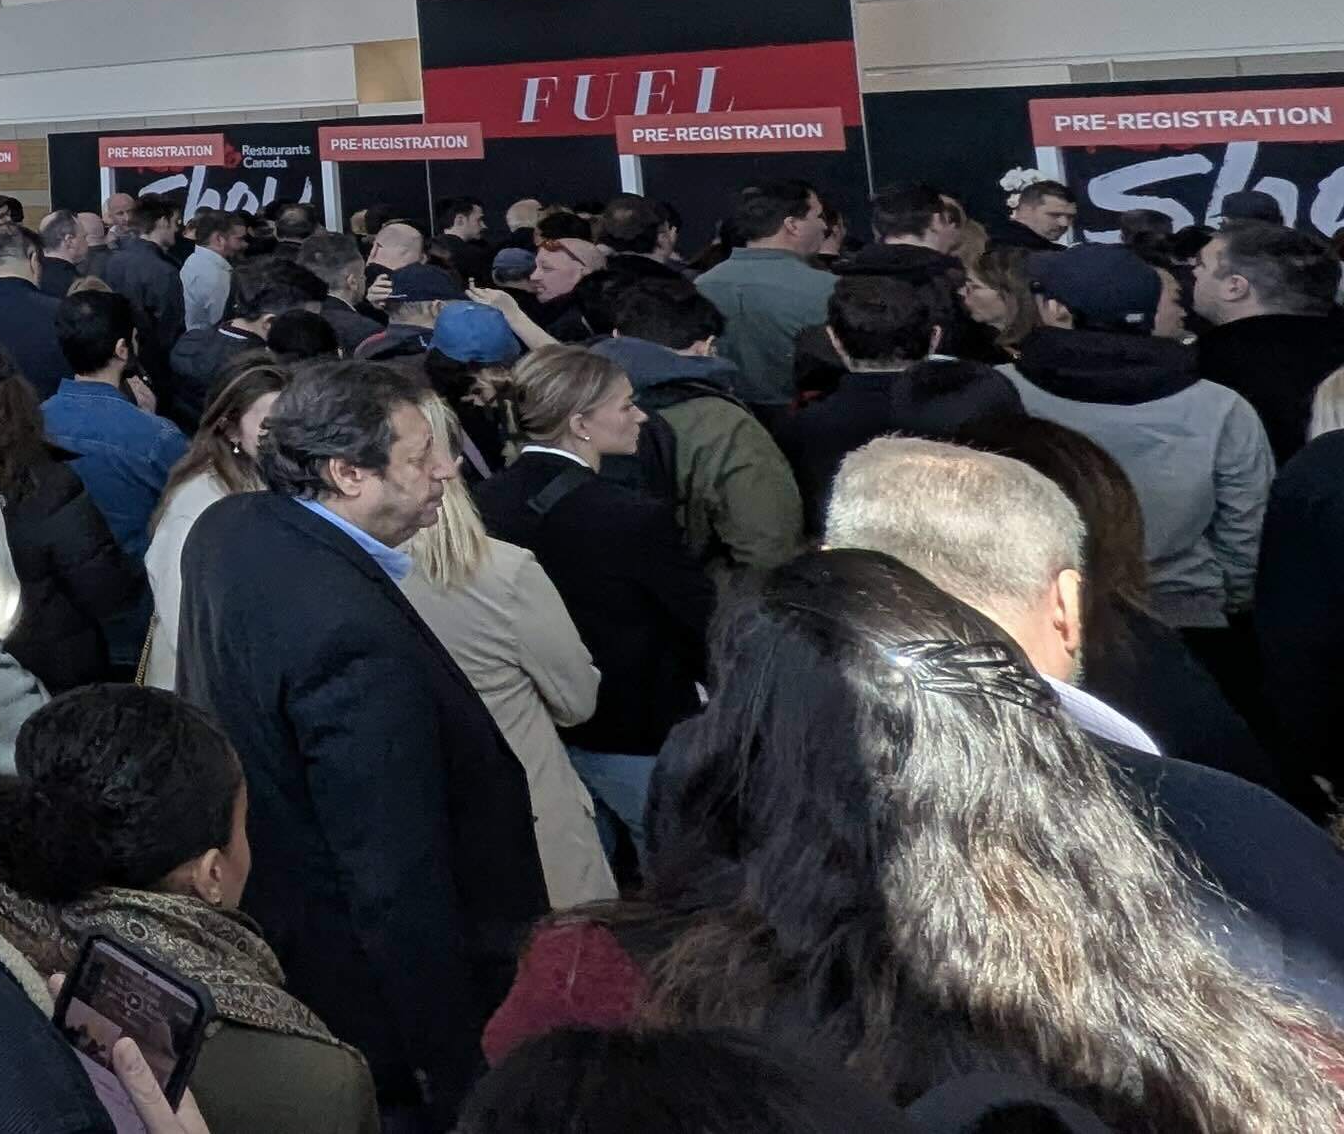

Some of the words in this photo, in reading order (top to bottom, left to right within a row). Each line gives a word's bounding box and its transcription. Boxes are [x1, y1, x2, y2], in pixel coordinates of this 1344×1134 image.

[517, 66, 736, 124] FUEL
[1054, 105, 1332, 132] PRE-REGISTRATION
[631, 122, 824, 144] PRE-REGISTRATION
[108, 145, 213, 158] PRE-REGISTRATION
[242, 144, 311, 156] Restaurants
[330, 134, 469, 152] PRE-REGISTRATION
[243, 156, 288, 168] Canada
